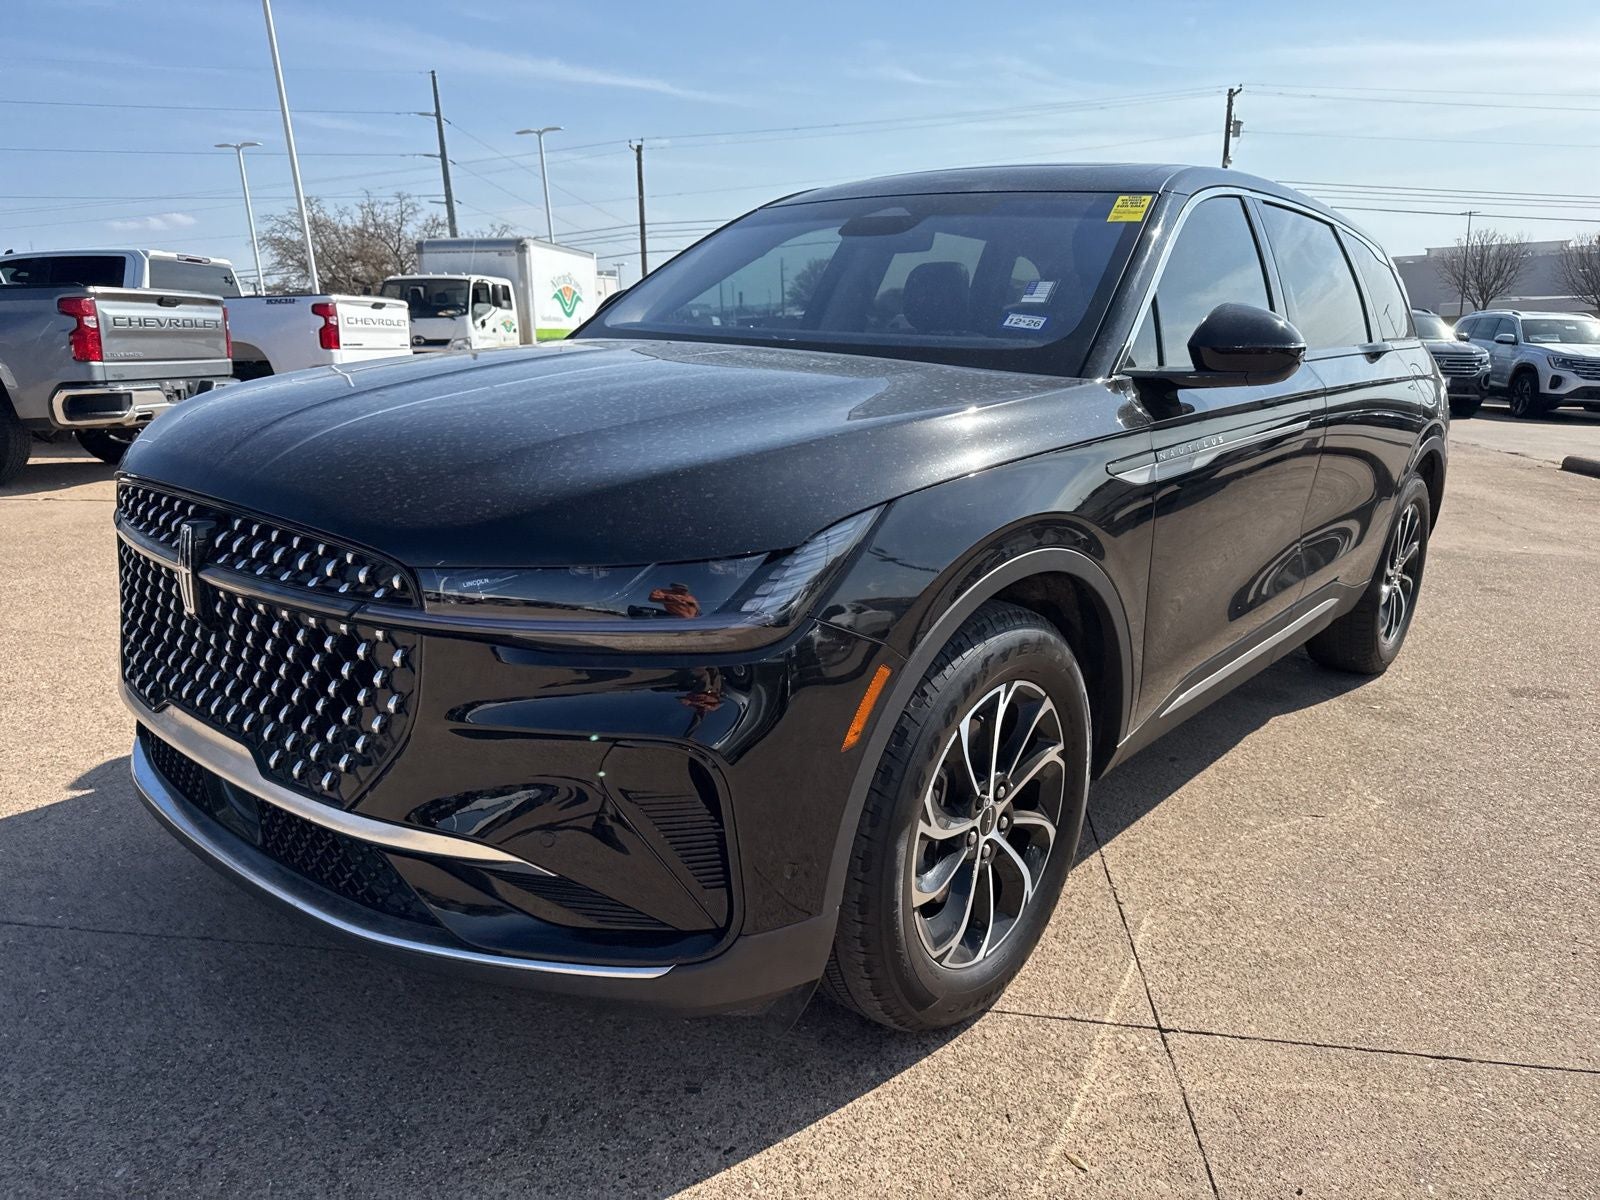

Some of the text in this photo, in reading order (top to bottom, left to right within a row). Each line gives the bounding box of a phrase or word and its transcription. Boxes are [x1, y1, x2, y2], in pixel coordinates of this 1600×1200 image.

[112, 316, 221, 329] CHEVROLET
[346, 316, 407, 328] CHEVROLET
[1159, 435, 1224, 460] NAUTILUS
[462, 578, 489, 588] LINCOLN
